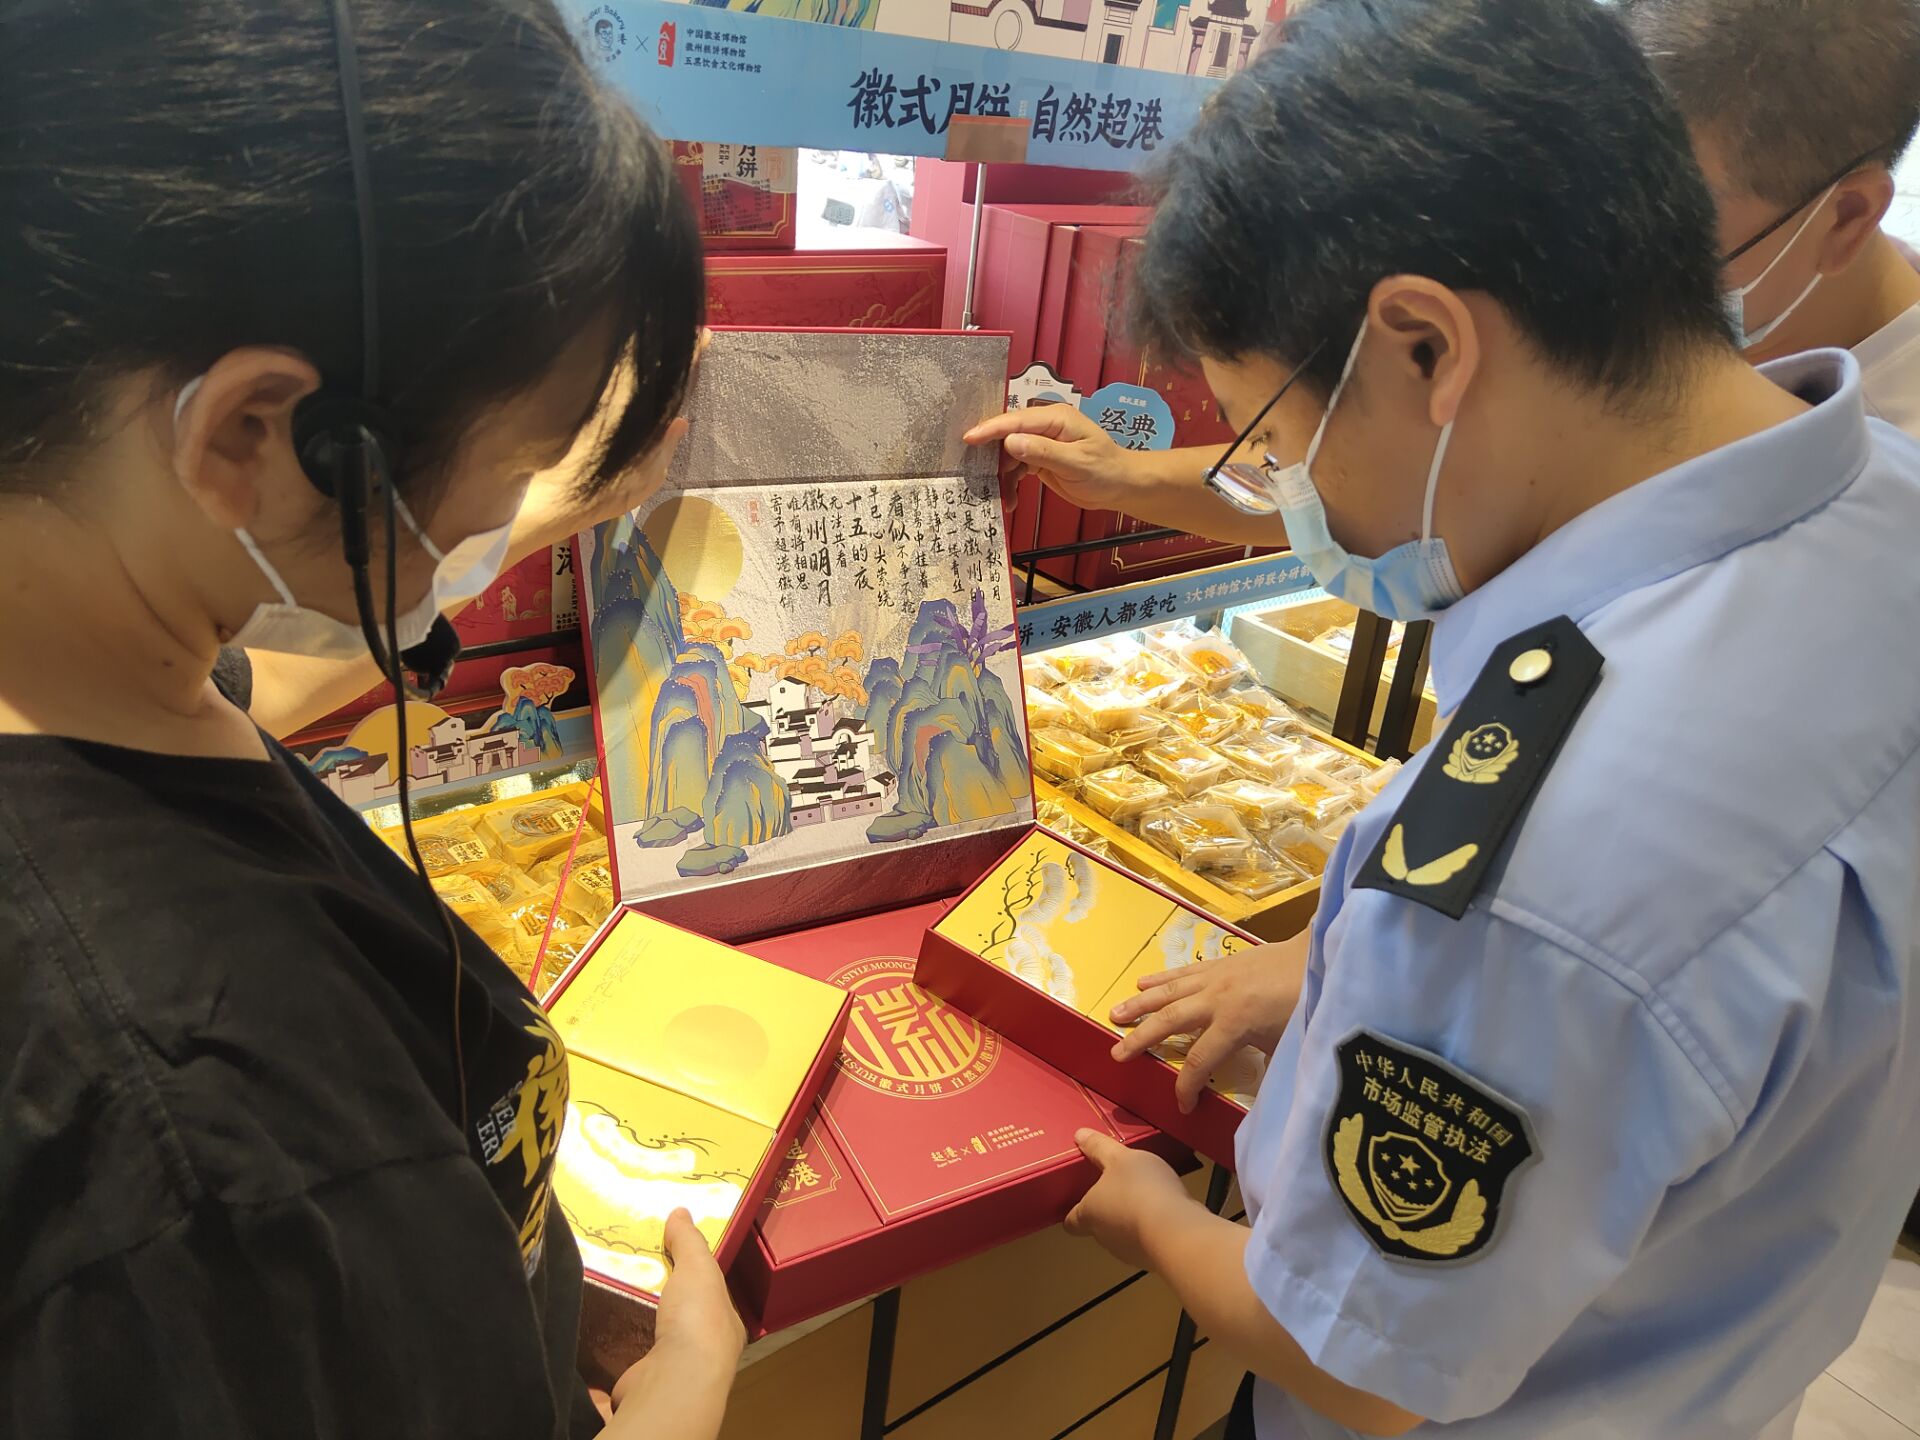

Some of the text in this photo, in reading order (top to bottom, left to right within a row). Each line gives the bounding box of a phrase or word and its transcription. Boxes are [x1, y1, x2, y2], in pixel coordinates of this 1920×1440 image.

[1032, 85, 1164, 151] 自然超港
[1100, 406, 1158, 441] 经典
[802, 487, 832, 608] 徽州明月
[846, 491, 874, 590] 十五的夜
[879, 1077, 943, 1095] 徽式月饼
[1355, 1050, 1514, 1147] 中华人民共和国
[1362, 1076, 1492, 1164] 市场监管执法
